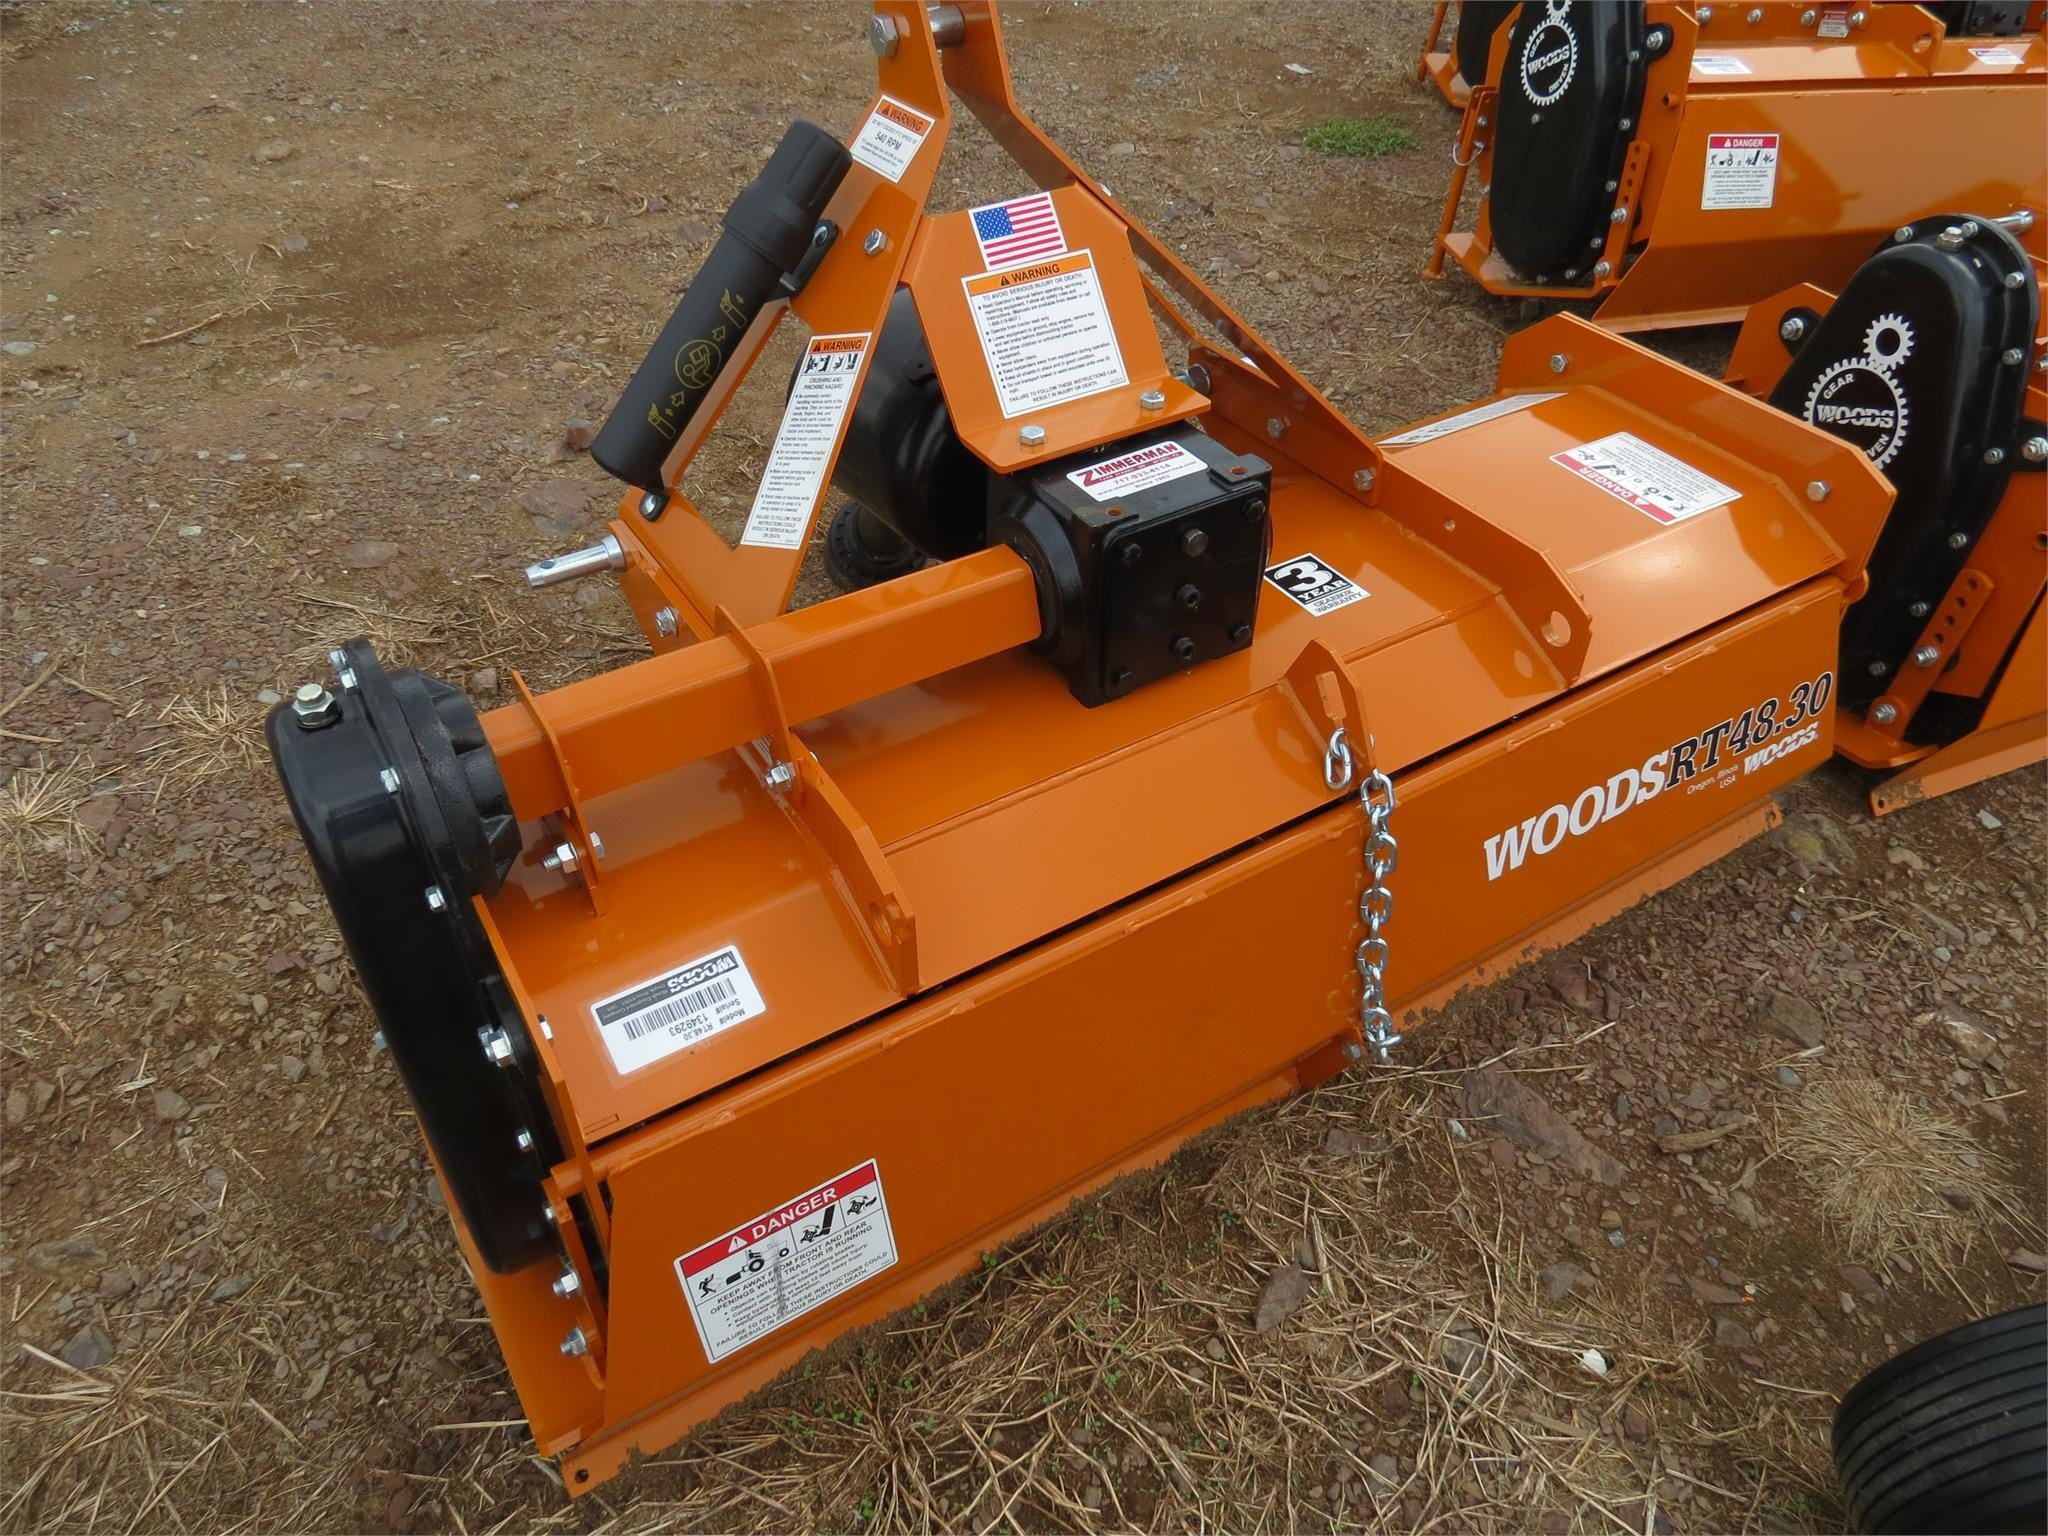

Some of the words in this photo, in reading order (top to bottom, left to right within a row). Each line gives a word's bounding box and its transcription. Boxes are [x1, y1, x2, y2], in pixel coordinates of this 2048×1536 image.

[1530, 32, 1544, 58] GEAR
[1528, 44, 1570, 75] WOODS
[890, 108, 924, 131] WARNING
[887, 137, 902, 151] RPM
[1733, 139, 1764, 147] DANGER
[1011, 263, 1060, 283] WARNING
[991, 290, 1008, 298] AVOID
[1009, 284, 1034, 294] SERIOUS
[1034, 279, 1053, 288] INJURY
[823, 340, 862, 350] WARNING
[1008, 393, 1029, 402] FAILURE
[1037, 385, 1057, 394] FOLLOW
[1057, 381, 1073, 389] THESE
[1073, 371, 1106, 384] INSTRUCTIONS
[1032, 393, 1051, 402] RESULT
[1056, 387, 1074, 395] INJURY
[1824, 373, 1854, 400] GEAR
[1816, 404, 1894, 428] WOODS
[1865, 434, 1889, 458] VEN
[1076, 444, 1178, 487] ZIMMERMAN
[1579, 467, 1634, 498] DANGER
[1274, 561, 1333, 592] 3
[1296, 580, 1348, 600] YEAR
[1314, 589, 1354, 607] GEARBOX
[1314, 591, 1362, 612] WARRANTY
[1744, 721, 1819, 775] WOODS
[1720, 774, 1736, 788] USA
[667, 955, 736, 993] WOODS
[713, 996, 740, 1015] Serial#
[718, 1007, 745, 1024] Model#
[667, 1011, 708, 1037] 1349293
[682, 1022, 713, 1041] RT48.30
[751, 1186, 837, 1239] DANGER
[716, 1287, 741, 1304] KEEP
[741, 1273, 766, 1291] AWAY
[767, 1260, 792, 1277] FOM
[793, 1244, 822, 1263] FRONT
[824, 1233, 843, 1247] AND
[843, 1220, 867, 1237] REAR
[709, 1287, 755, 1315] OPENINGS
[756, 1272, 782, 1290] WHE
[784, 1250, 823, 1275] TRACTOR
[825, 1245, 833, 1254] IS
[730, 1296, 755, 1312] Objects
[755, 1289, 768, 1299] can
[768, 1284, 777, 1292] be
[800, 1267, 808, 1275] by
[809, 1254, 833, 1270] rotating
[732, 1301, 757, 1318] Contact
[757, 1293, 772, 1305] with
[797, 1269, 818, 1283] blades
[819, 1262, 830, 1272] will
[830, 1252, 849, 1266] cause
[734, 1311, 751, 1325] Keep
[787, 1288, 794, 1296] at
[794, 1280, 810, 1292] least
[819, 1268, 831, 1279] feet
[832, 1260, 847, 1272] away
[848, 1251, 863, 1263] from
[716, 1327, 746, 1347] FAILURE
[747, 1321, 757, 1330] TO
[758, 1304, 789, 1324] FOLL
[790, 1291, 812, 1307] THESE
[813, 1264, 863, 1294] INSTRUCTIONS
[864, 1251, 887, 1267] COULD
[738, 1323, 766, 1341] RESULT
[766, 1318, 774, 1326] IN
[807, 1287, 832, 1304] INJURY
[832, 1281, 843, 1290] OR
[735, 1307, 769, 1328] equipment
